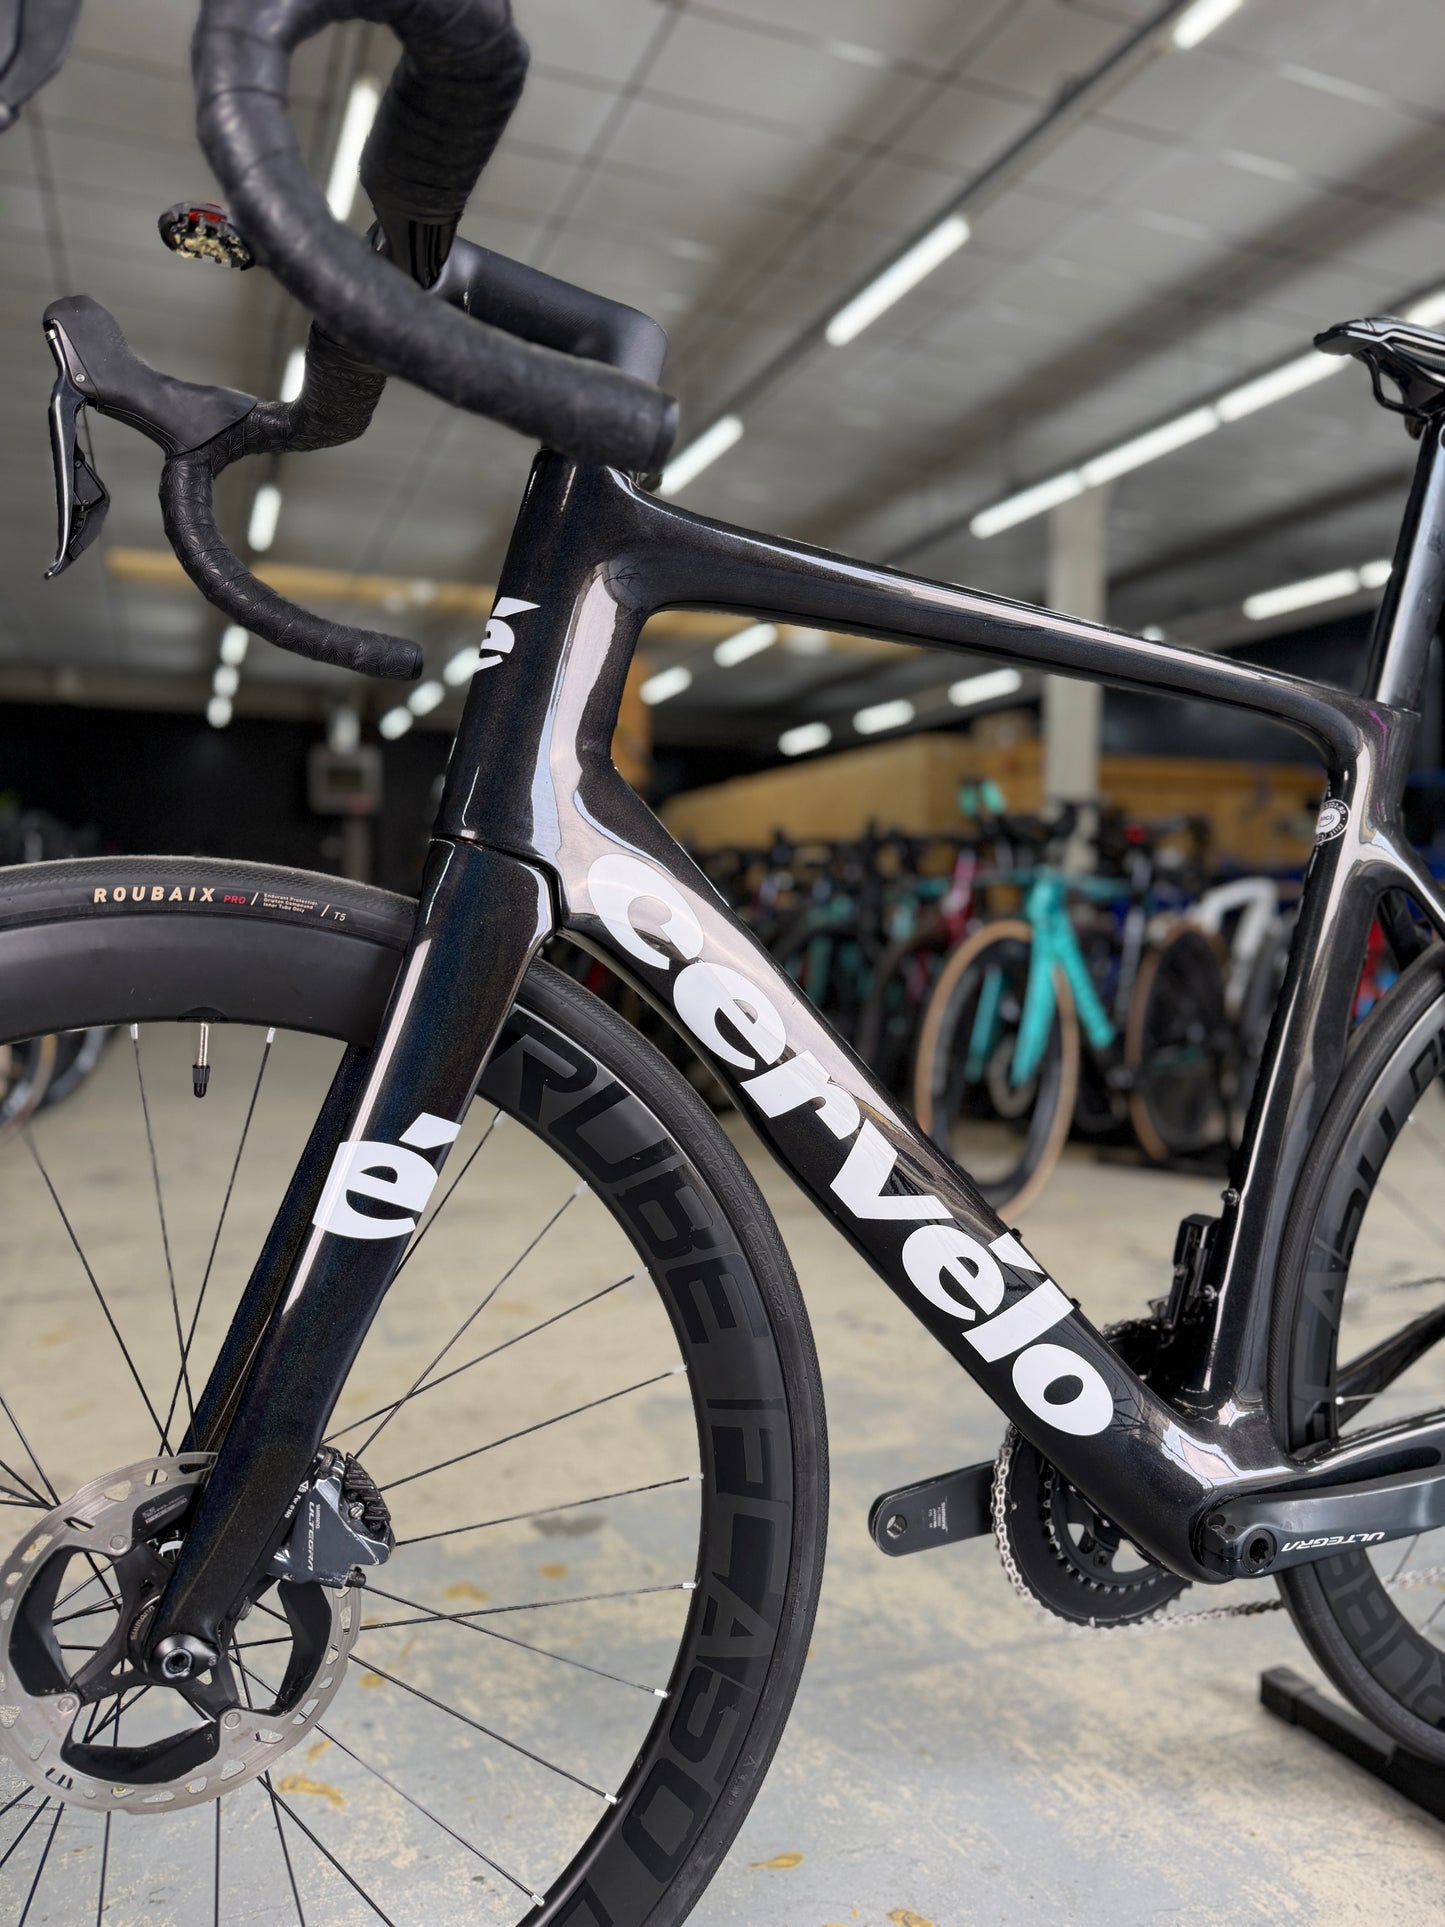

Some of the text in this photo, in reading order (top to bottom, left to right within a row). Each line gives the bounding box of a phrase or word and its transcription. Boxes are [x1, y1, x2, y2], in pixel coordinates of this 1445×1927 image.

[93, 886, 246, 905] ROUBAIX PRO
[333, 911, 347, 922] T5
[587, 853, 1114, 1436] cervélo
[312, 1112, 461, 1240] é
[307, 1501, 315, 1572] ULTEGRA
[1281, 1531, 1386, 1553] ULTEGRA
